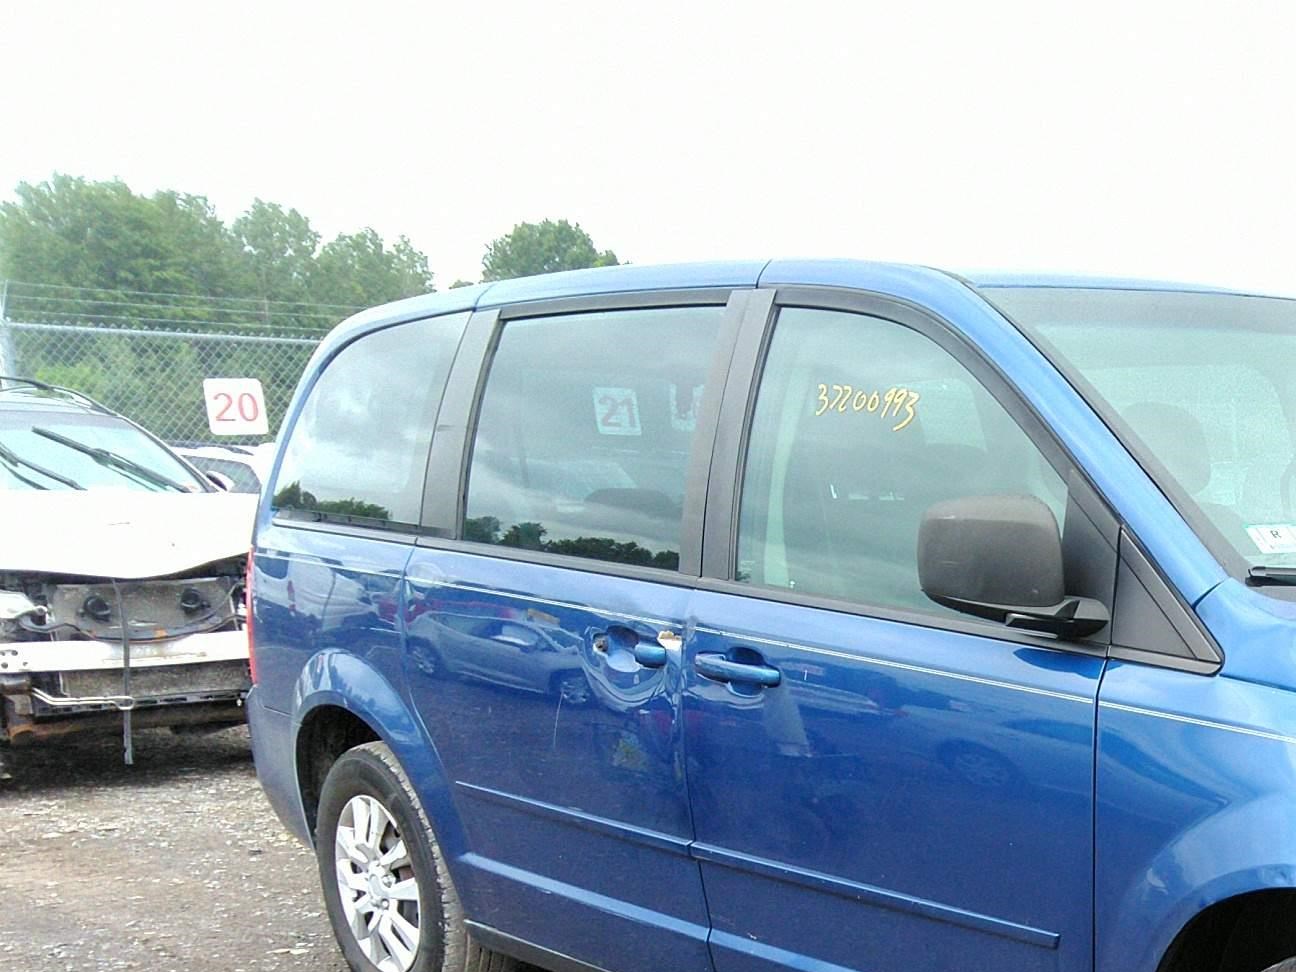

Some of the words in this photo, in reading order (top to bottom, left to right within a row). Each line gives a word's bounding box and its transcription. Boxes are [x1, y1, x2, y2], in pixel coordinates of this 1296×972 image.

[213, 392, 259, 422] 20
[599, 396, 637, 428] 21
[815, 383, 920, 432] 37200993
